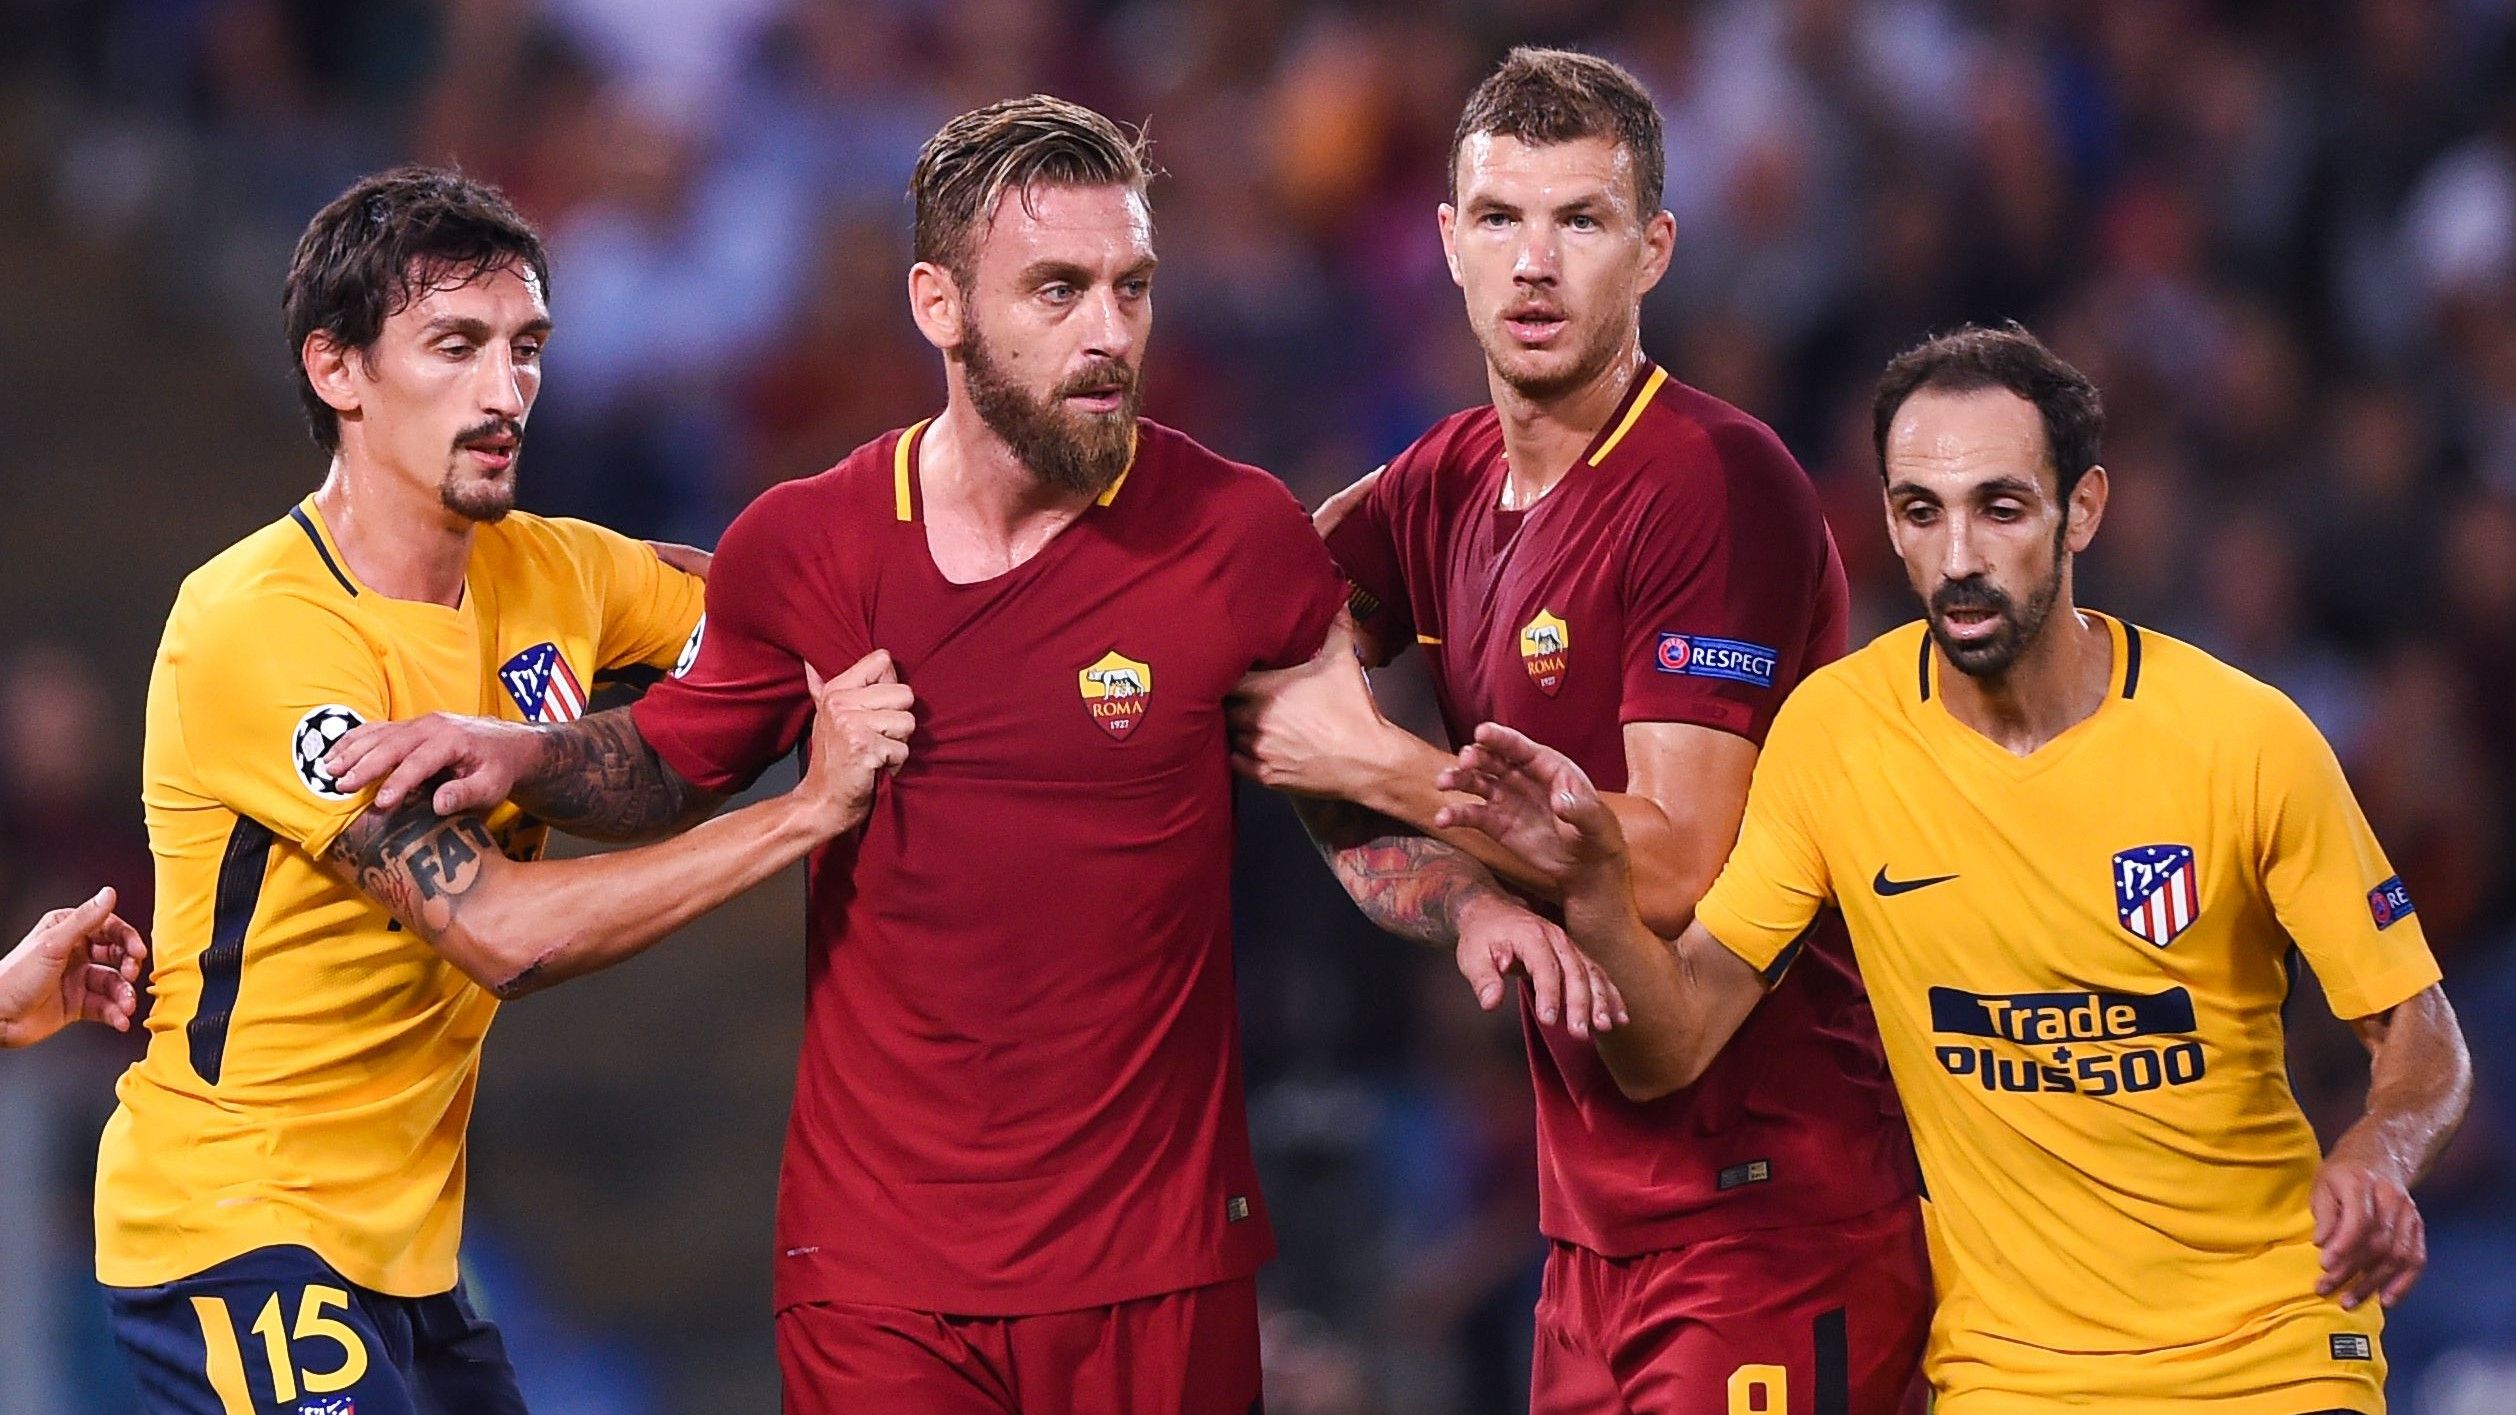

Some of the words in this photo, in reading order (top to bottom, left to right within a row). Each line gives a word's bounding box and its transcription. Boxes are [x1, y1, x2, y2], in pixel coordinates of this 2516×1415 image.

[1527, 657, 1566, 676] ROMA
[1692, 647, 1775, 677] RESPECT
[1092, 700, 1143, 717] ROMA
[1977, 995, 2136, 1041] Trade
[1934, 1041, 2206, 1096] Plus500
[250, 1284, 369, 1405] 15
